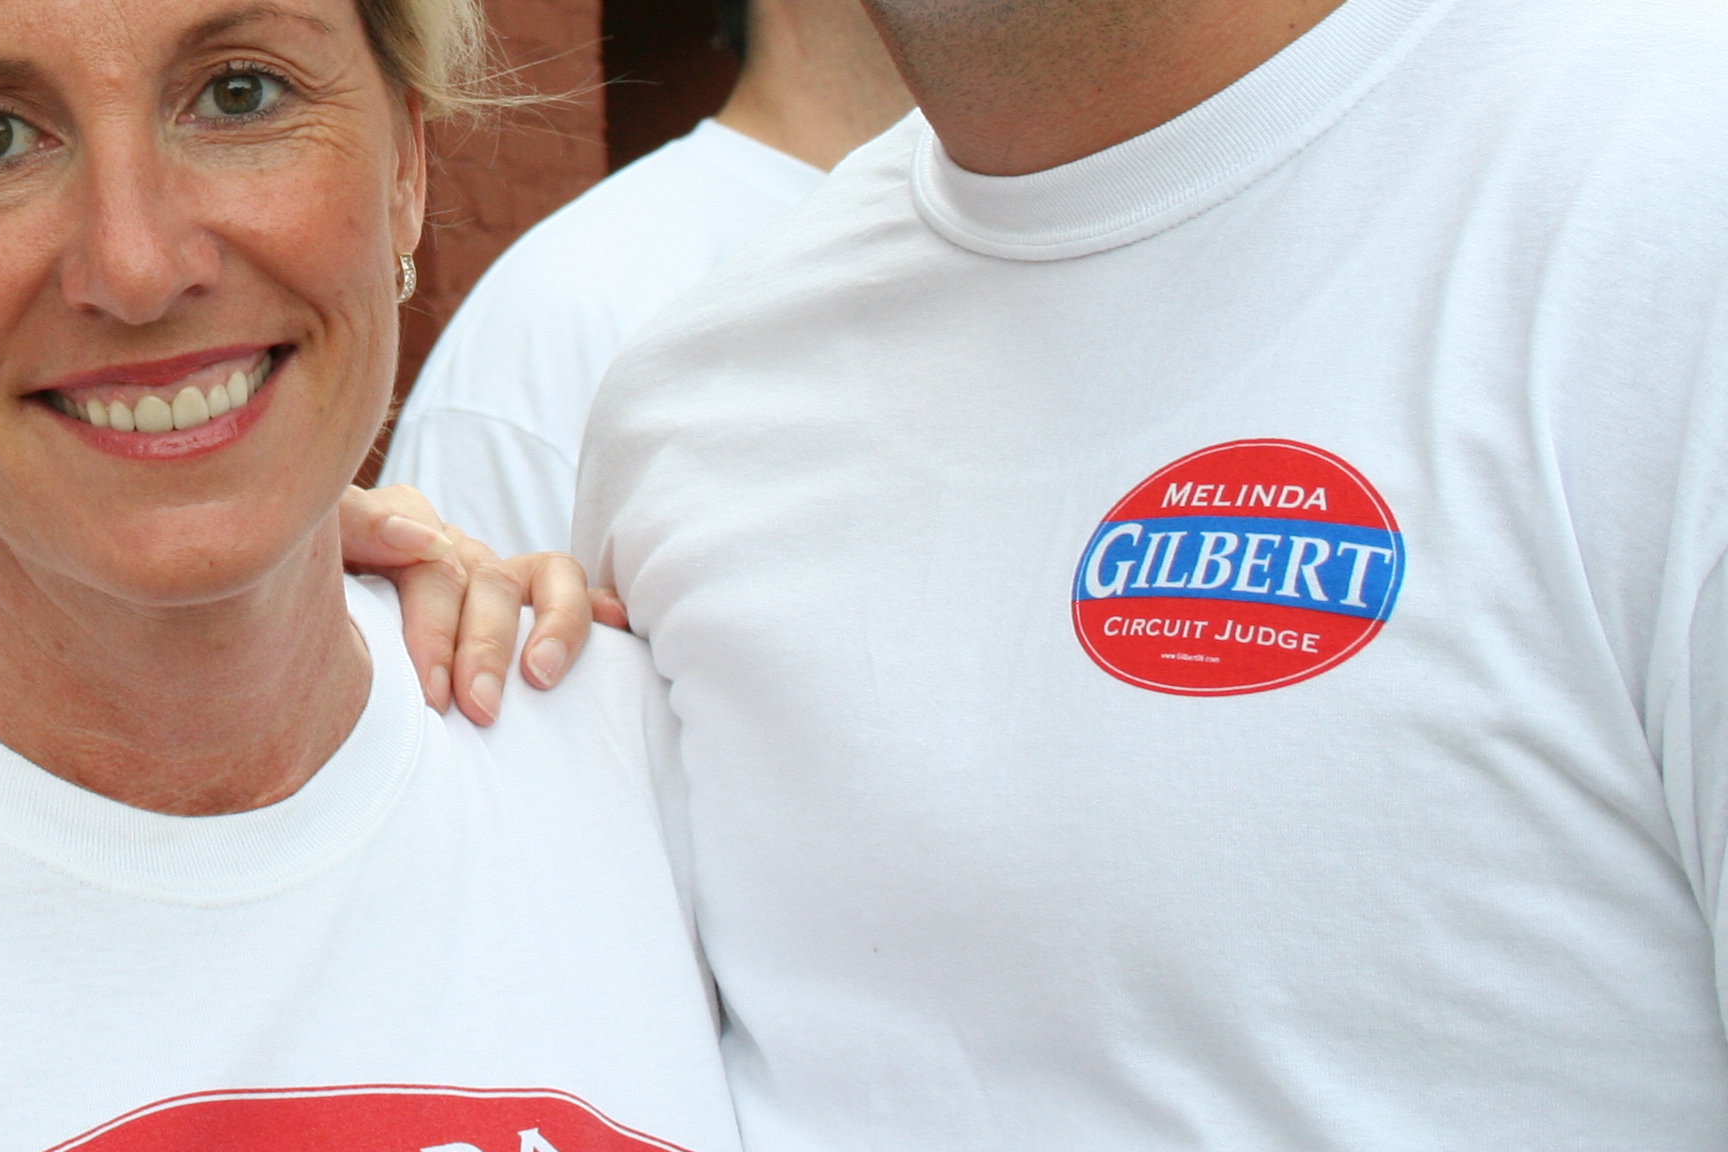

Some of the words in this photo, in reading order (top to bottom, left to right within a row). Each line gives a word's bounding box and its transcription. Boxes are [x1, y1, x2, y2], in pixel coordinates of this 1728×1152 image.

[1161, 481, 1328, 510] MELINDA
[1085, 522, 1392, 608] GILBERT
[1103, 616, 1208, 639] CIRCUIT
[1214, 619, 1320, 654] JUDGE
